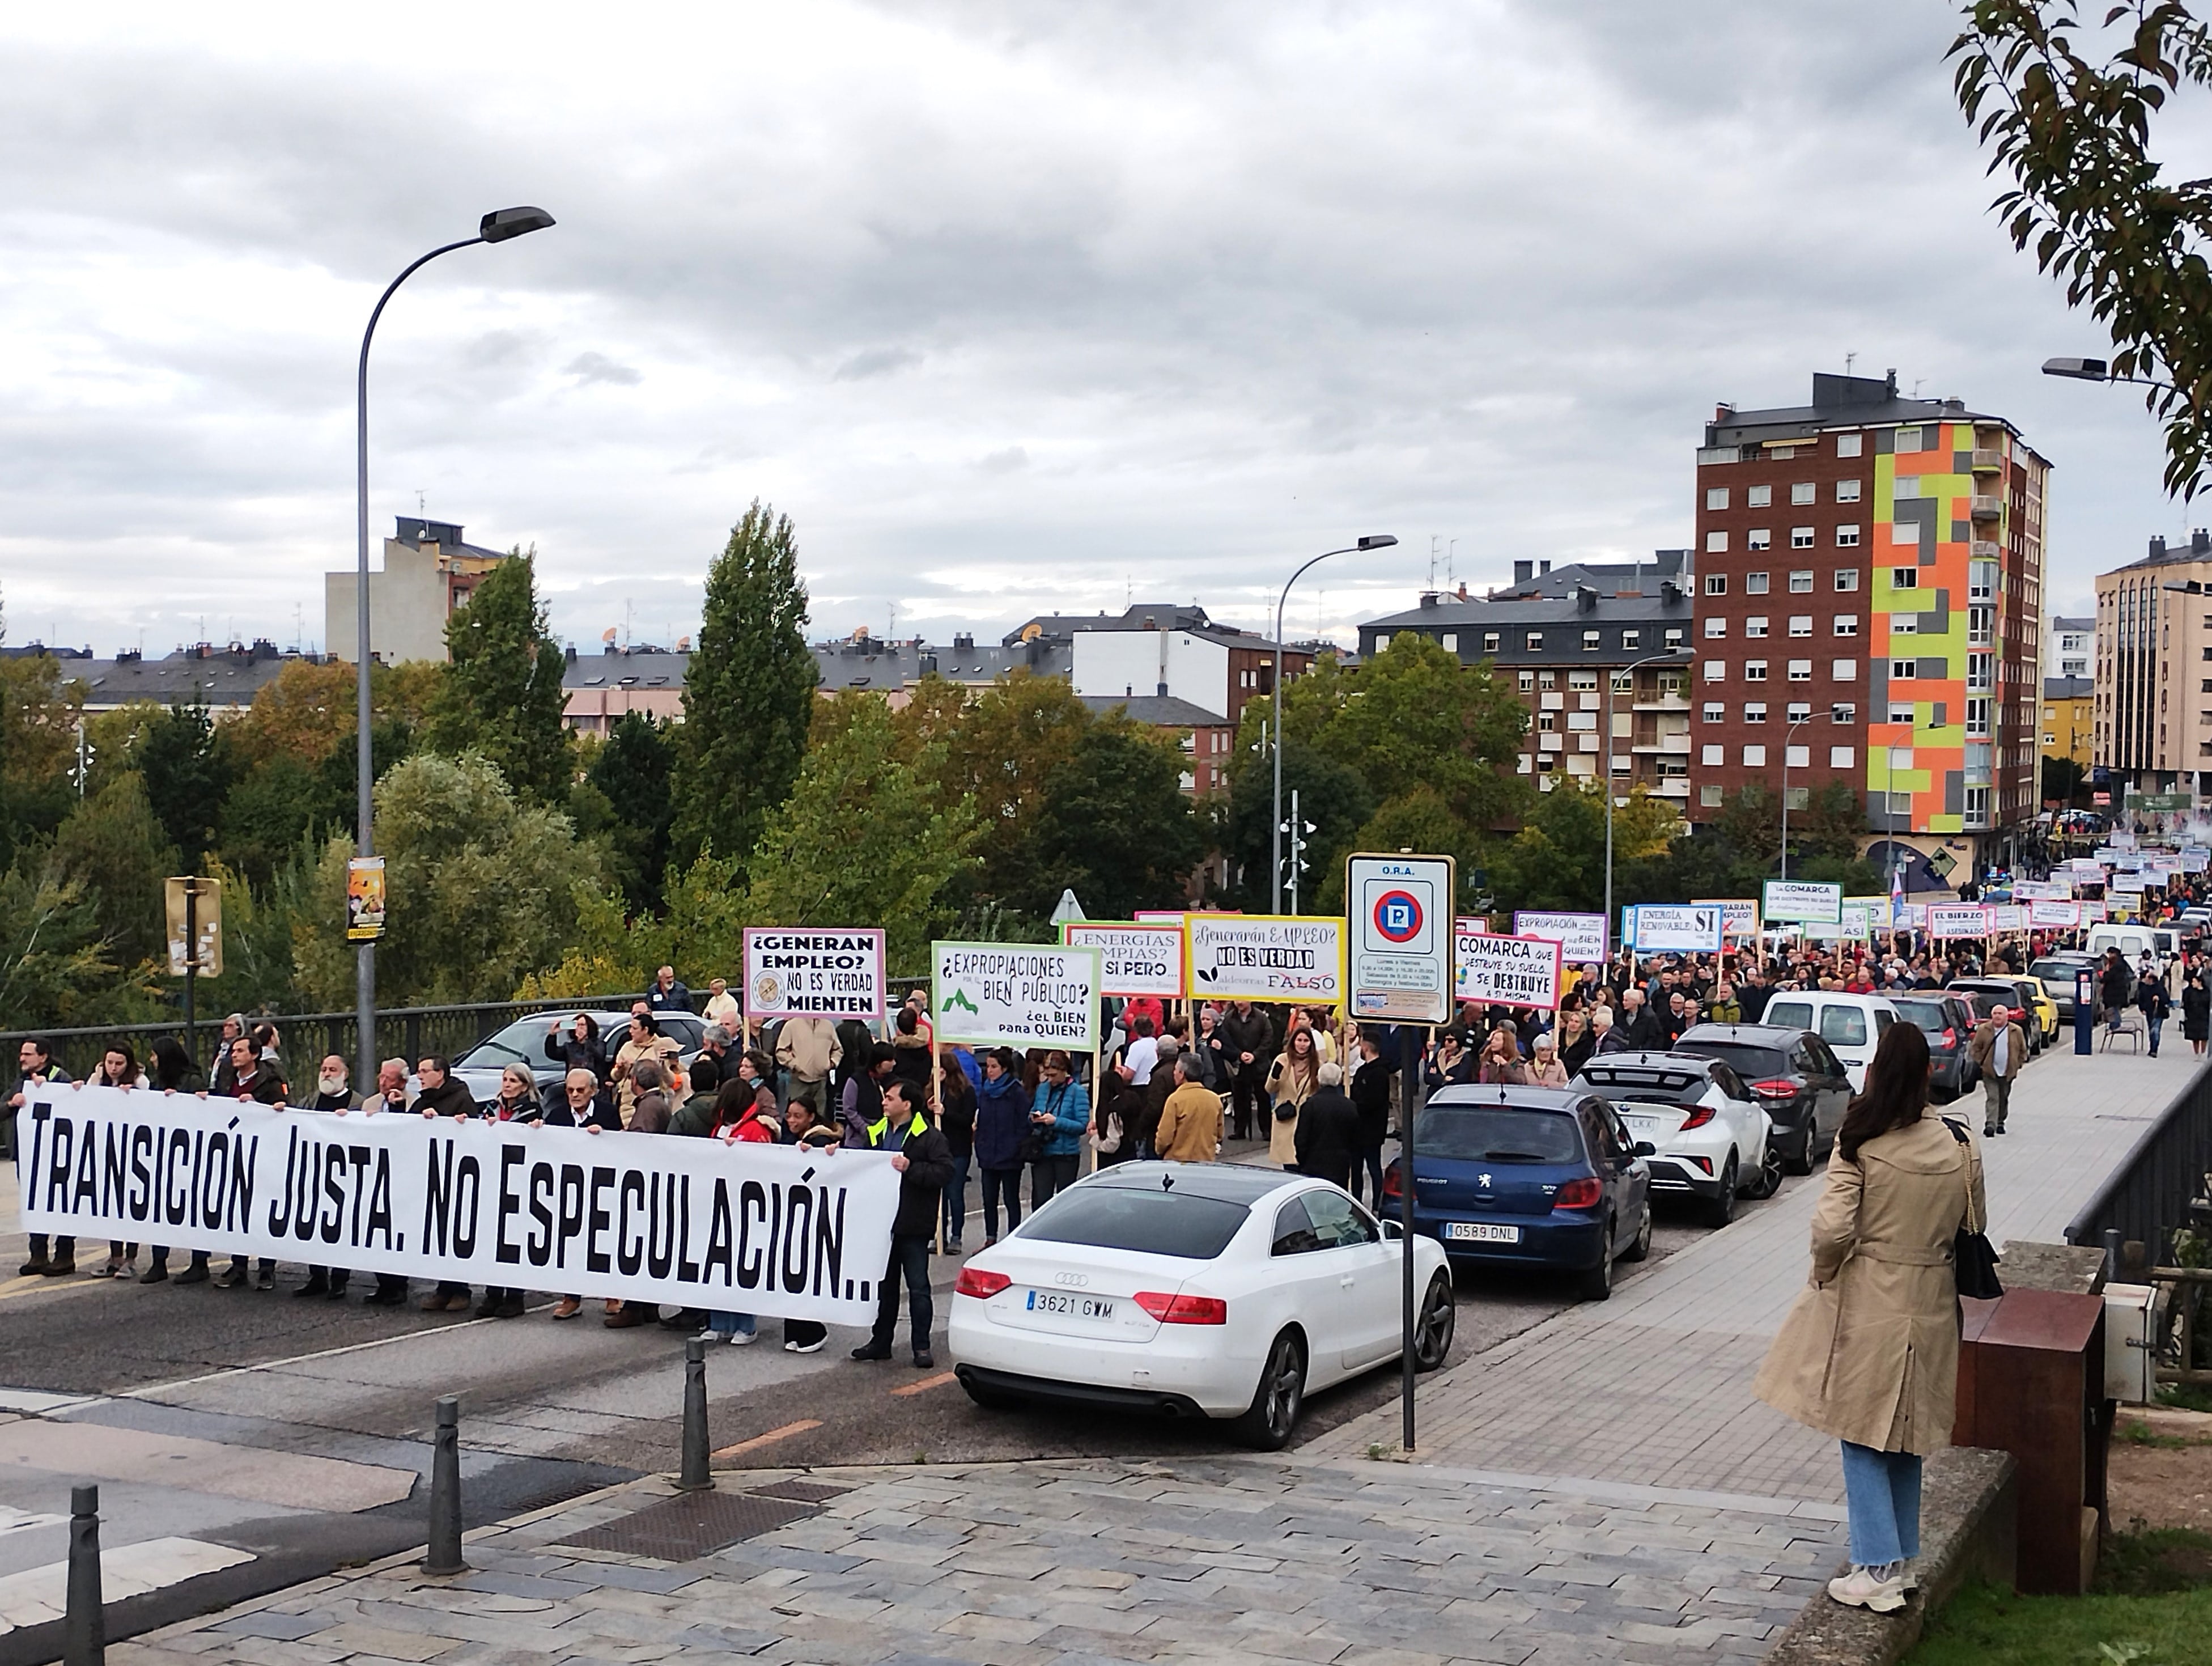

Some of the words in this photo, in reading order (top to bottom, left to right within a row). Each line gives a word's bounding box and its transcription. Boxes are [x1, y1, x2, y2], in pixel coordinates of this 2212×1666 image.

[1382, 866, 1415, 875] O.R.A.
[1785, 885, 1830, 893] COMARCA
[1519, 917, 1577, 930] EXPROPIACIÓN
[753, 936, 873, 951] ¿GENERAN
[1074, 933, 1175, 947] ¿ENERGÍAS
[1195, 926, 1266, 947] ¿Generarán
[1101, 947, 1167, 960] MPIAS?
[1459, 937, 1531, 959] COMARCA
[1535, 950, 1552, 960] QUE
[762, 955, 865, 970] EMPLEO?
[1217, 947, 1236, 966] NO
[1239, 947, 1256, 966] ES
[1259, 948, 1314, 969] VERDAD
[942, 953, 1064, 979] ¿EXPROPIACIONES
[1505, 961, 1515, 971] SU
[787, 972, 802, 990] NO
[810, 973, 822, 991] ES
[831, 973, 872, 991] VERDAD
[1267, 975, 1335, 990] FALSO
[1494, 973, 1550, 994] DESTRUYE
[984, 977, 1014, 1004] BIEN
[1505, 991, 1531, 1001] MISMA
[787, 995, 873, 1012] MIENTEN
[1054, 1011, 1086, 1024] BIEN
[1034, 1024, 1086, 1037] QUIEN?
[1633, 1118, 1651, 1128] LKX
[27, 1102, 257, 1234] TRANSICIÓN
[269, 1125, 404, 1251] JUSTA.
[423, 1138, 479, 1260] NO
[1455, 1225, 1487, 1238] 0589
[1491, 1227, 1514, 1240] DNL
[1038, 1295, 1075, 1314] 3621
[1082, 1300, 1113, 1319] GWM
